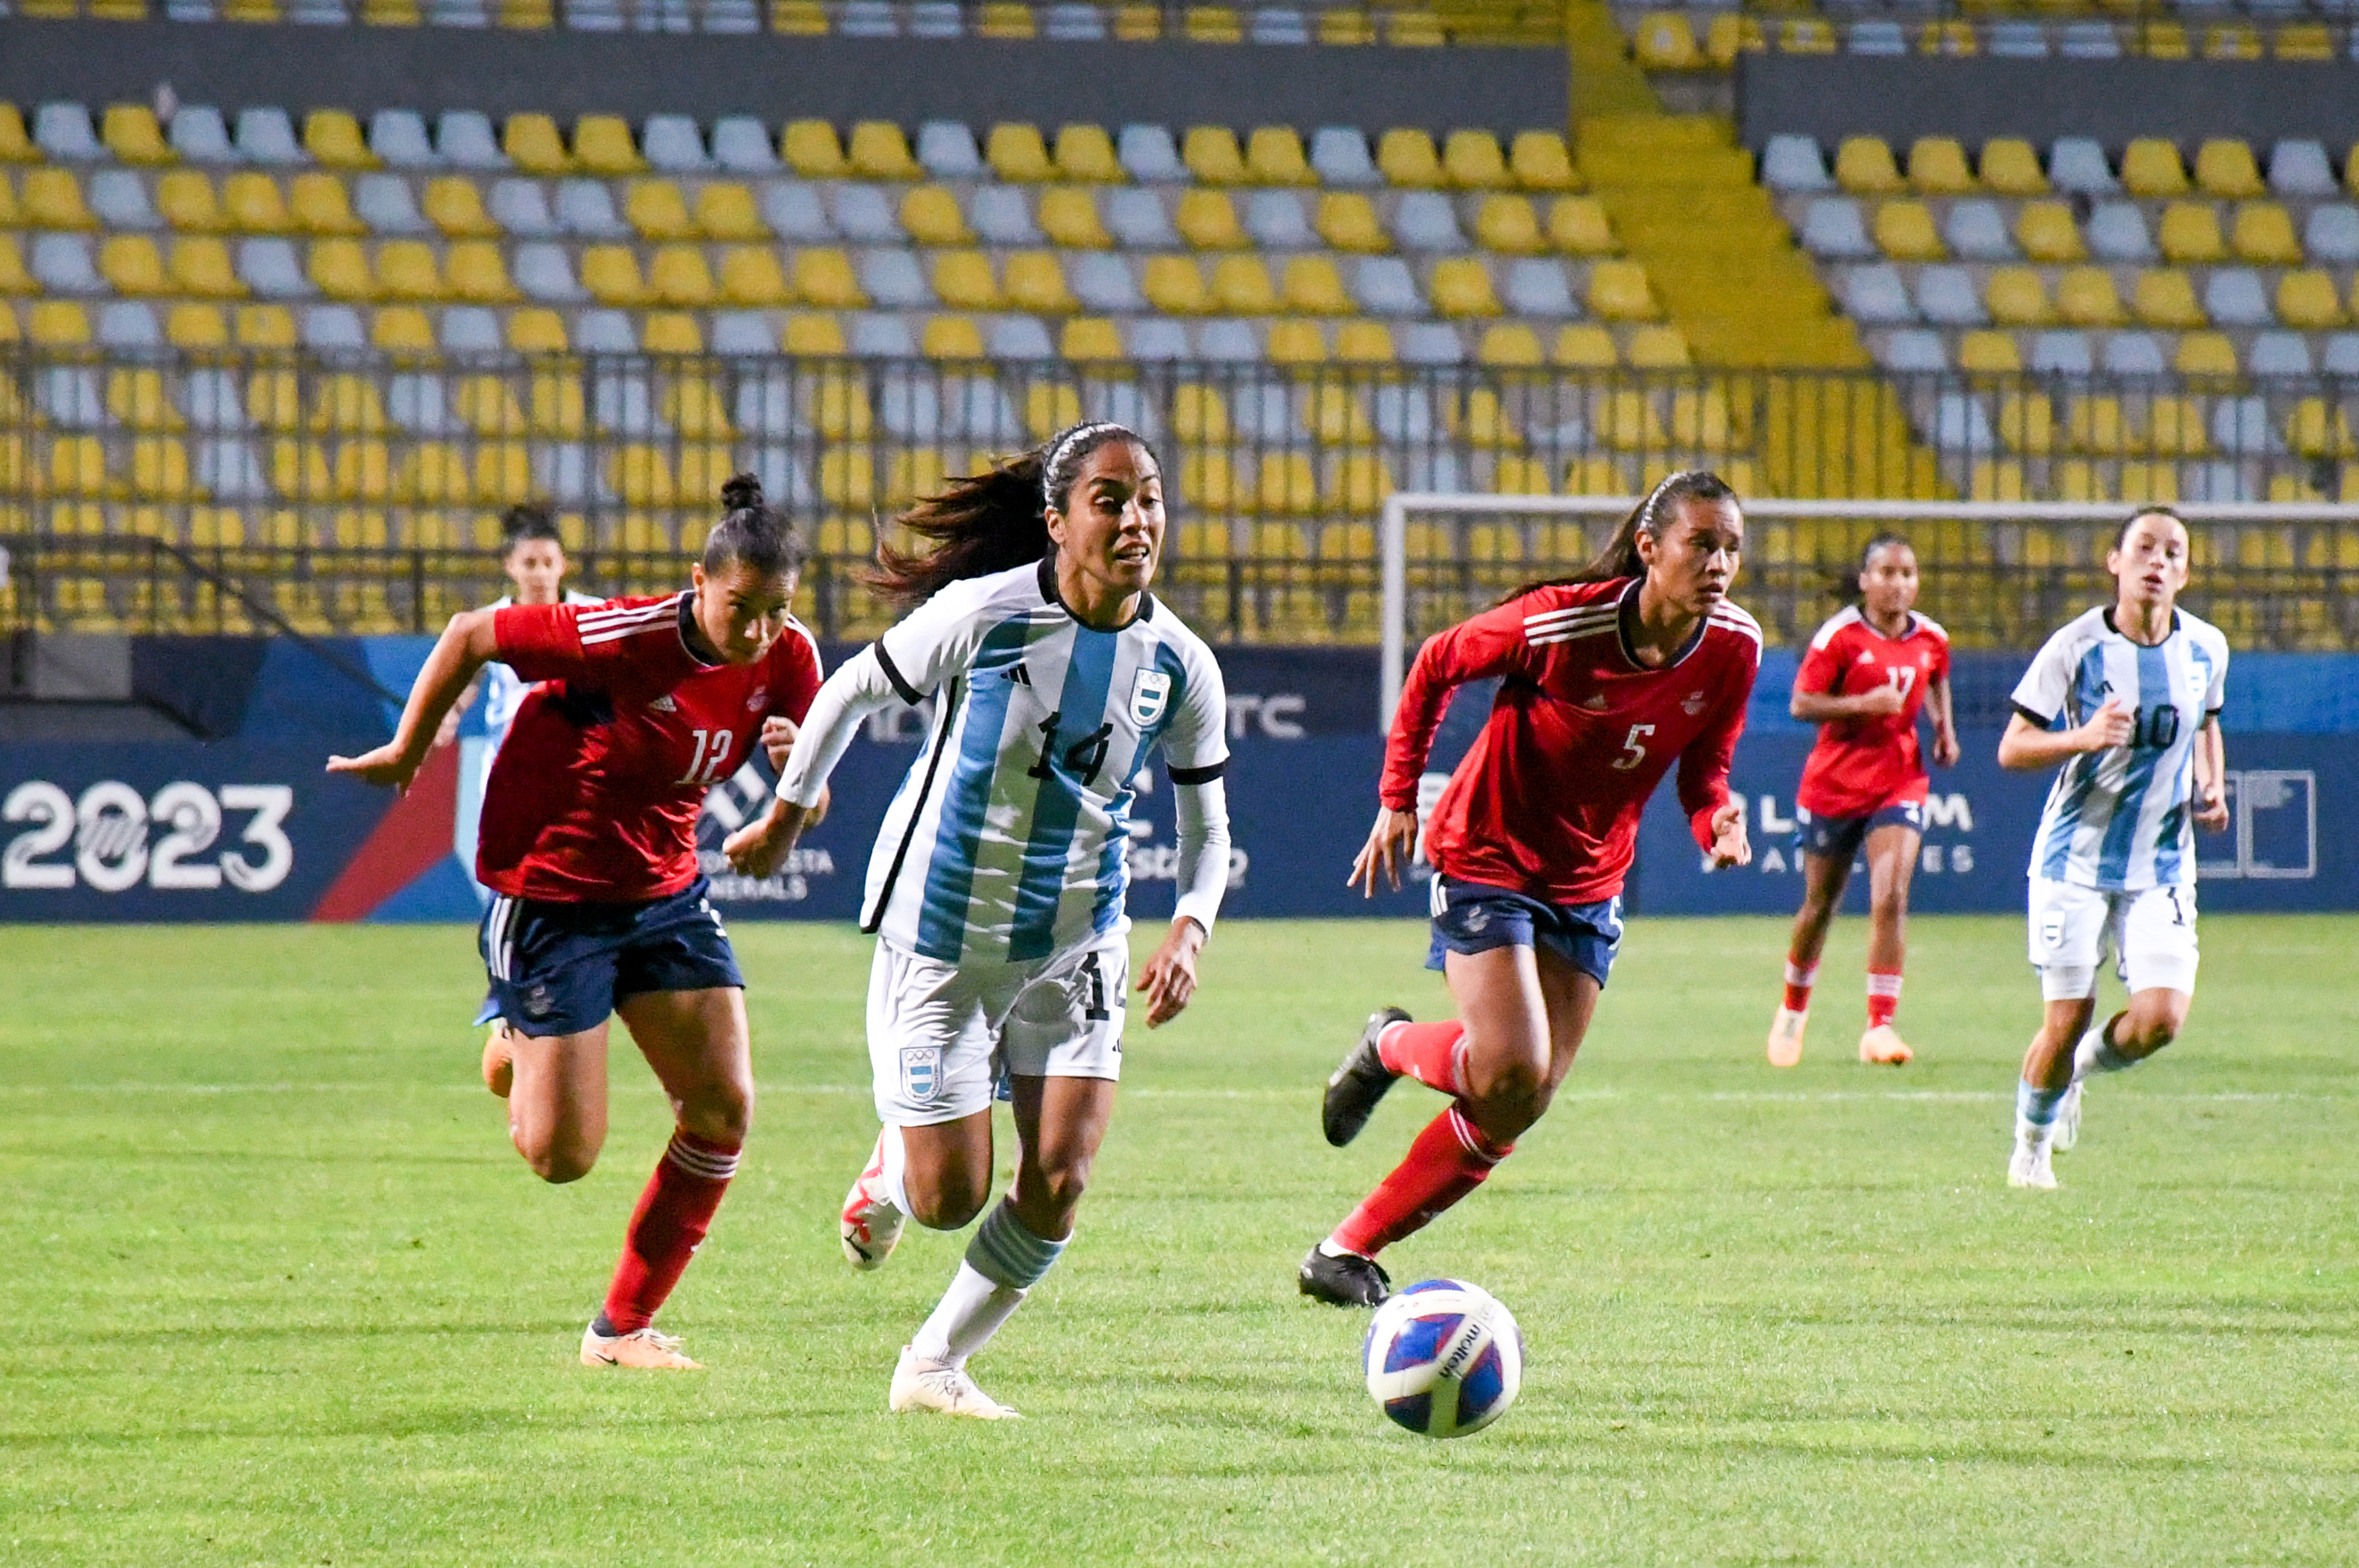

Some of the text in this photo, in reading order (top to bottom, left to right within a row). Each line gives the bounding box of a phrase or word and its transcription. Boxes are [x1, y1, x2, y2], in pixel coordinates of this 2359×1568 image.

[1886, 666, 1917, 703] 17
[1027, 711, 1114, 787] 14
[1611, 724, 1656, 770] 5
[2129, 704, 2179, 751] 10
[678, 729, 733, 784] 12
[3, 780, 294, 892] 2023
[1438, 1323, 1481, 1378] molten
